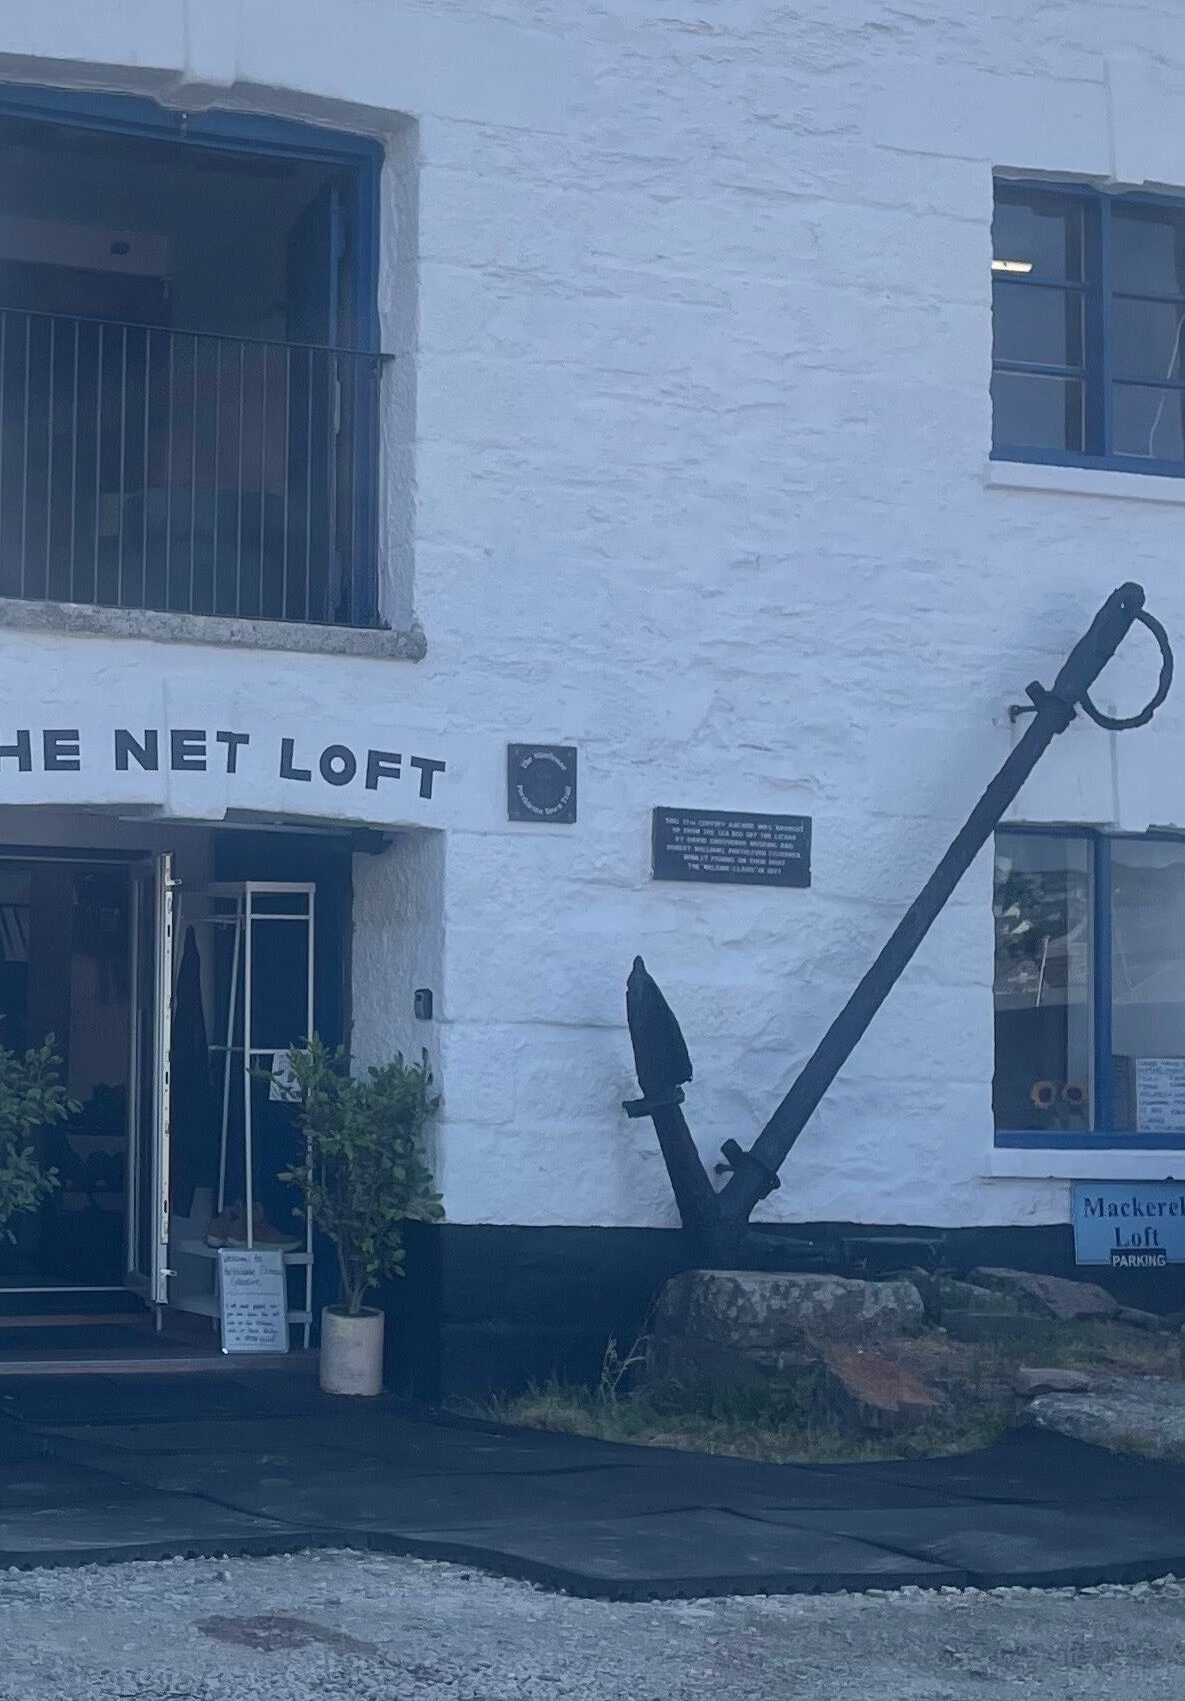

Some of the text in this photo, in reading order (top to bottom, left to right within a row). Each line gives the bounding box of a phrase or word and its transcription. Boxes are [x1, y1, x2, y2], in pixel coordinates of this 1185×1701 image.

[114, 729, 250, 773] NET
[279, 737, 446, 800] LOFT
[1114, 1225, 1160, 1248] Loft
[1112, 1254, 1167, 1268] PARKING
